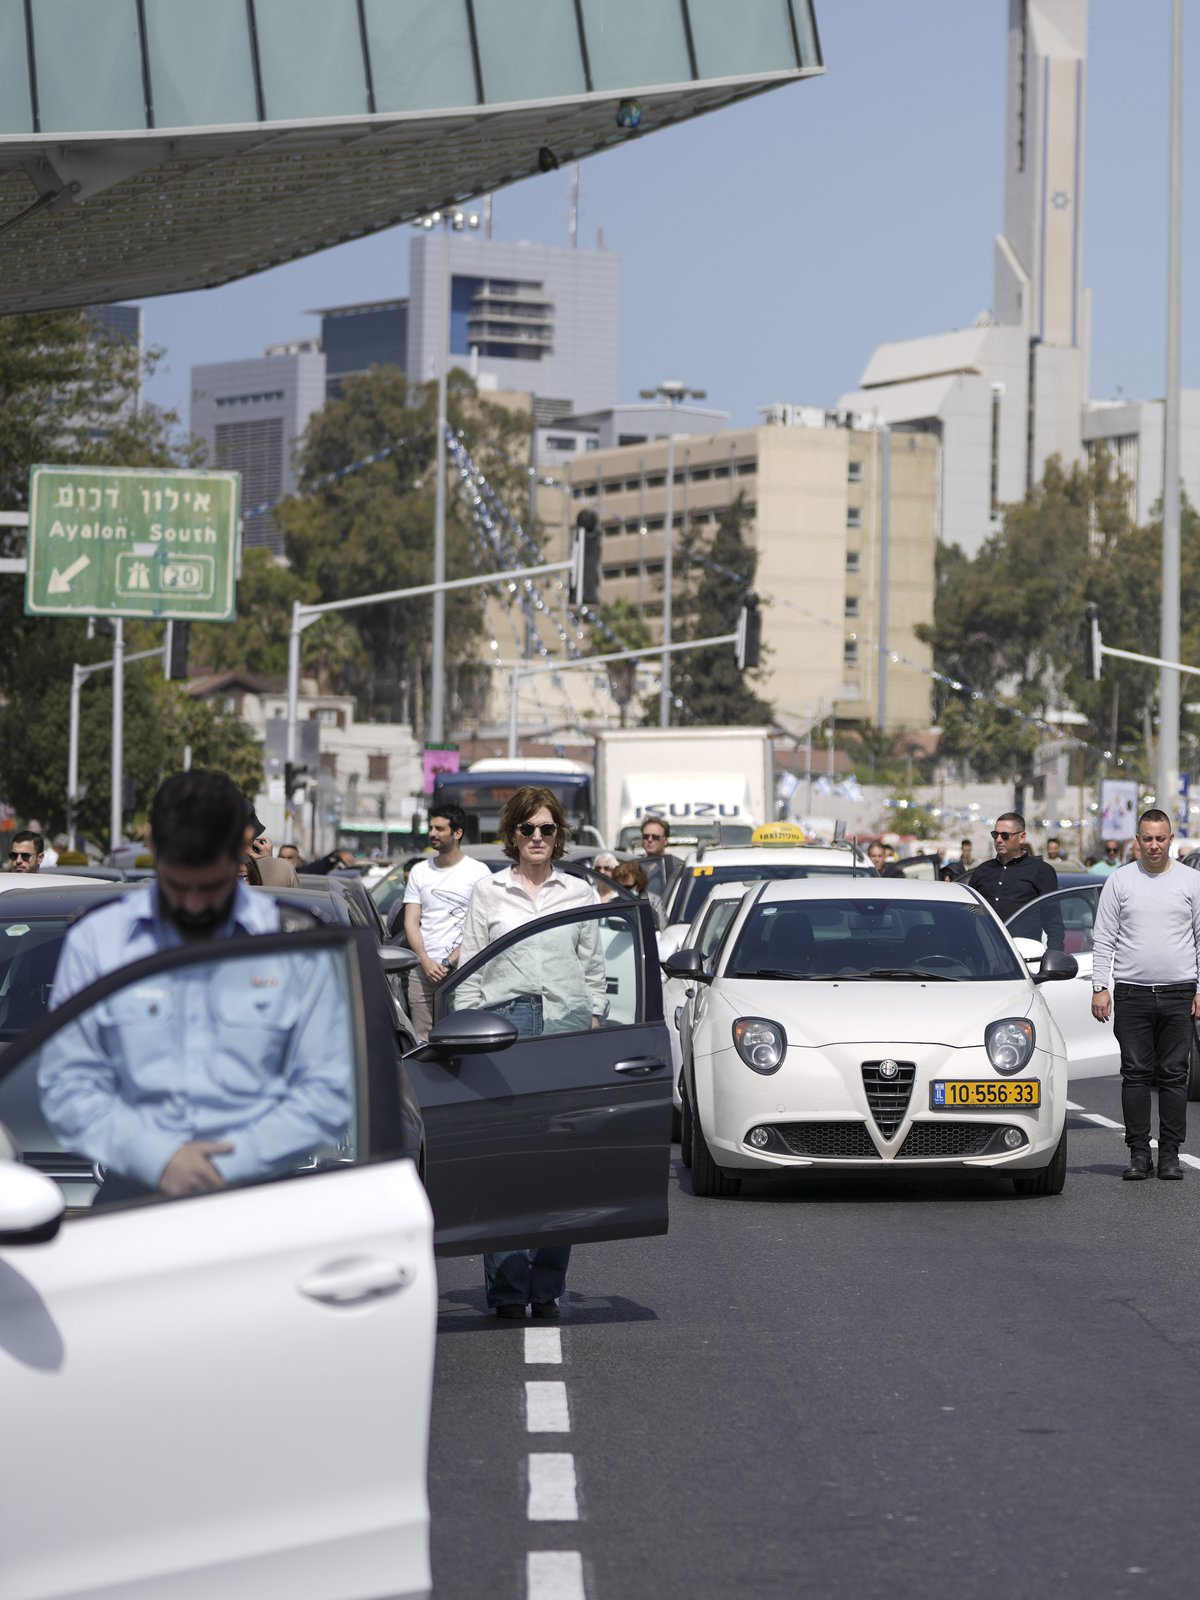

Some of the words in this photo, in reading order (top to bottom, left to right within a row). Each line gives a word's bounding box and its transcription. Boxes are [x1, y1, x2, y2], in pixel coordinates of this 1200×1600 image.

[141, 487, 211, 514] אילון
[49, 520, 127, 542] Ayalon
[149, 523, 217, 543] South
[636, 803, 740, 818] ISUZU
